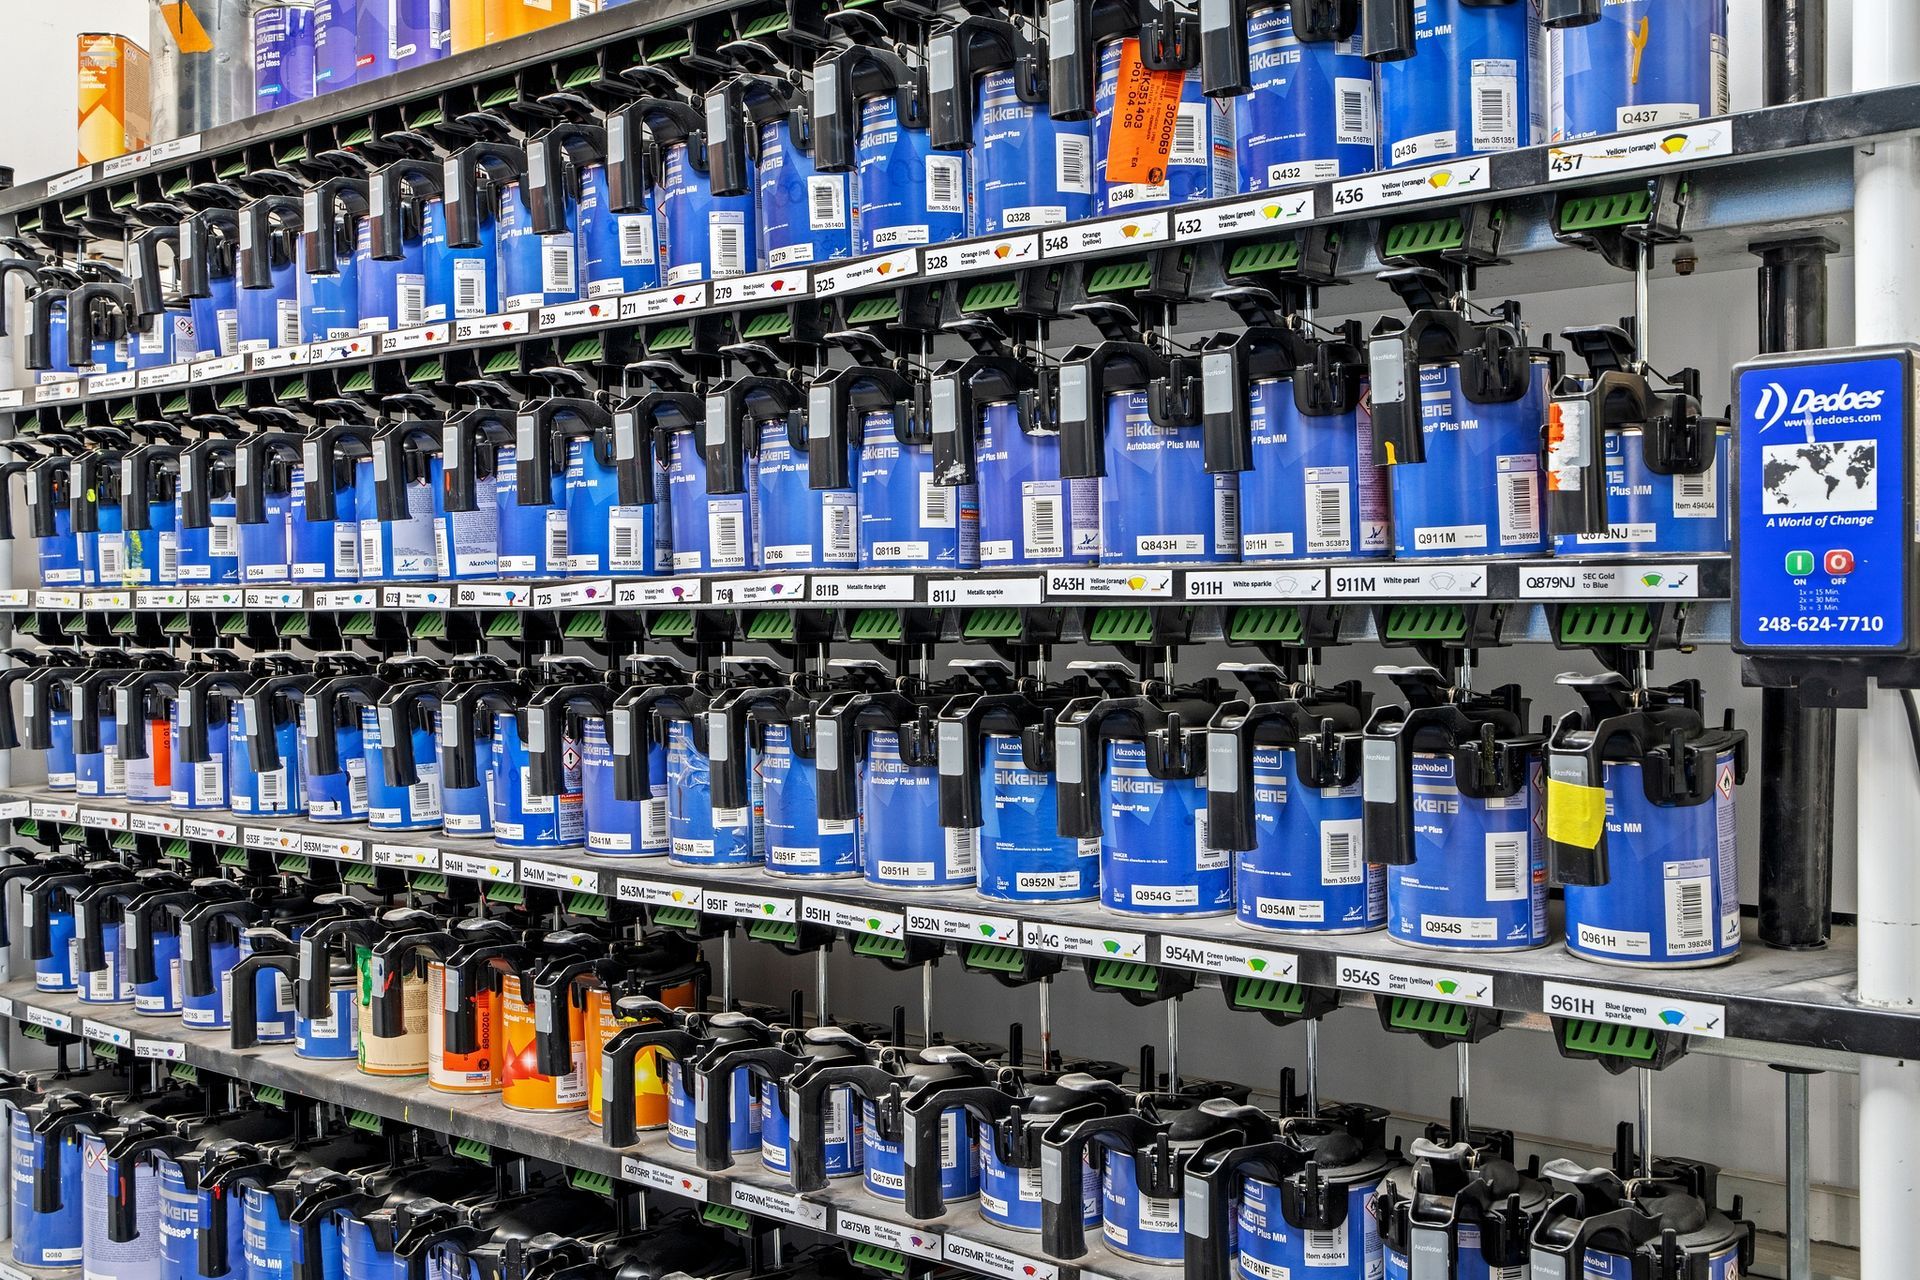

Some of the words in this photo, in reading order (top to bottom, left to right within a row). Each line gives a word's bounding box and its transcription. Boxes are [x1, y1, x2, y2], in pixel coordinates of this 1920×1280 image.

[1250, 16, 1290, 32] AkzoNobel
[1123, 62, 1142, 128] P01.04.05
[1622, 110, 1658, 124] Q437
[1158, 104, 1176, 154] 3020069
[1394, 144, 1417, 158] Q436
[1551, 154, 1583, 173] 437
[1606, 146, 1628, 158] Yellow
[1629, 142, 1657, 156] (orange)
[1272, 168, 1300, 180] Q432
[1112, 188, 1134, 202] Q348
[1335, 188, 1364, 205] 436
[1382, 181, 1400, 190] Yellow
[1401, 176, 1426, 188] (orange)
[1006, 212, 1030, 223] Q328
[1177, 218, 1202, 235] 432
[1218, 212, 1235, 221] Yellow
[1236, 208, 1256, 220] (green)
[876, 232, 897, 244] Q325
[1044, 236, 1068, 252] 348
[1082, 230, 1101, 240] Orange
[1082, 238, 1102, 247] (yellow)
[770, 252, 786, 263] Q279
[927, 255, 948, 270] 328
[978, 248, 990, 258] (red)
[816, 278, 835, 292] 325
[846, 270, 862, 279] Orange
[862, 267, 874, 276] (red)
[715, 287, 732, 300] 279
[622, 303, 636, 315] 271
[540, 314, 556, 326] 239
[458, 326, 472, 337] 235
[384, 338, 396, 348] 232
[312, 348, 322, 359] 231
[1790, 384, 1886, 414] Dedoes
[1784, 414, 1882, 428] www.dedoes.com
[1766, 520, 1775, 528] A
[1778, 516, 1812, 528] World
[1815, 516, 1828, 528] of
[1830, 514, 1874, 526] Change
[1418, 532, 1456, 544] Q911M
[1141, 540, 1178, 550] Q843H
[766, 550, 783, 560] Q766
[1052, 578, 1085, 590] 843H
[1106, 577, 1127, 585] (orange)
[1191, 581, 1223, 595] 911H
[1250, 580, 1272, 588] sparkle
[1336, 577, 1376, 592] 911M
[1403, 576, 1420, 584] pearl
[1526, 577, 1576, 588] Q879NJ
[460, 590, 475, 601] 680
[619, 590, 635, 602] 726
[816, 584, 839, 596] 811B
[932, 590, 956, 602] 811J
[986, 588, 1004, 596] sparkle
[137, 594, 147, 604] 550
[246, 594, 258, 604] 652
[536, 594, 551, 606] 725
[1758, 616, 1884, 632] 248-624-7710
[304, 841, 322, 852] 933M
[590, 836, 612, 845] Q941M
[674, 842, 694, 852] Q943M
[375, 852, 390, 862] 941F
[774, 851, 796, 861] Q951F
[445, 859, 463, 872] 941H
[881, 866, 910, 876] Q951H
[524, 869, 545, 881] 941M
[1020, 878, 1055, 888] Q952N
[620, 886, 645, 899] 943M
[1136, 890, 1172, 902] Q954G
[706, 898, 728, 910] 951F
[1260, 903, 1296, 916] Q954M
[806, 906, 830, 922] 951H
[849, 914, 866, 924] (yellow)
[910, 916, 940, 931] 952N
[958, 921, 970, 930] (blue)
[1426, 920, 1462, 934] Q954S
[1079, 938, 1094, 946] (blue)
[1581, 930, 1616, 948] Q961H
[1166, 946, 1204, 965] 954M
[1206, 952, 1224, 960] Green
[1224, 954, 1246, 964] (yellow)
[1206, 959, 1222, 967] pearl
[1342, 968, 1380, 986] 954S
[1389, 974, 1408, 982] Green
[1409, 976, 1434, 986] (yellow)
[1389, 982, 1406, 990] pearl
[1551, 994, 1594, 1015] 961H
[1606, 1002, 1621, 1011] Blue
[1622, 1004, 1648, 1015] (green)
[1605, 1011, 1632, 1021] sparkle
[624, 1164, 650, 1180] Q875RR
[652, 1175, 664, 1184] Rubine
[872, 1172, 903, 1186] Q875VB
[735, 1190, 766, 1206] Q878NM
[775, 1198, 790, 1208] Medium
[766, 1202, 782, 1212] Sparkling
[782, 1207, 796, 1216] Silver
[841, 1219, 870, 1235] Q875VB
[884, 1226, 902, 1237] Midcoat
[1140, 1218, 1154, 1226] Item
[1154, 1220, 1178, 1229] 557964
[948, 1243, 984, 1262] Q875MR
[984, 1251, 994, 1259] SEC
[994, 1254, 1014, 1265] Midcoat
[253, 1254, 266, 1267] Plus
[267, 1257, 282, 1270] MM
[984, 1258, 1002, 1268] Maroon
[1003, 1263, 1014, 1272] Red
[1242, 1256, 1271, 1276] Q878NF
